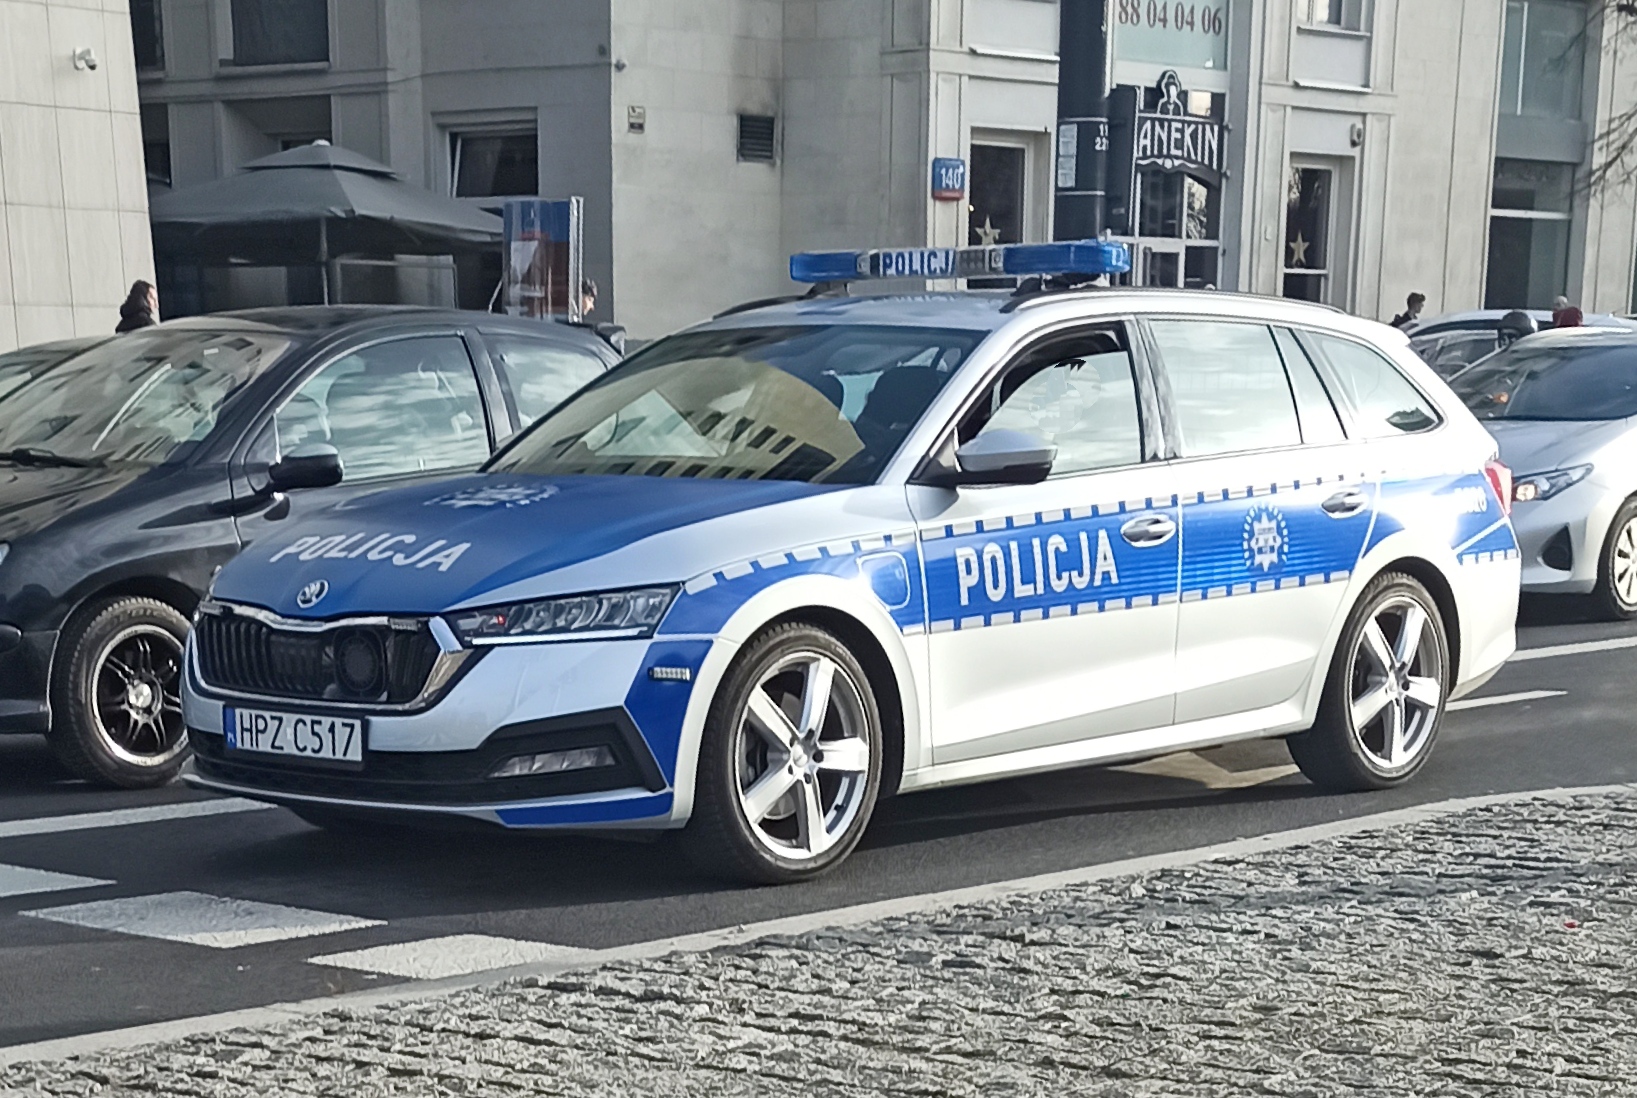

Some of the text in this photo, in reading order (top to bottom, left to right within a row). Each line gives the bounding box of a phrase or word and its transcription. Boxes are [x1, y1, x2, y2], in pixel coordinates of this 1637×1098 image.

[1119, 0, 1223, 36] 88 04 04 06
[1137, 119, 1219, 170] ANEKIN
[940, 167, 962, 189] 140
[269, 531, 472, 573] POLICJA
[954, 527, 1120, 607] POLICJA
[239, 711, 356, 758] HPZ C517
